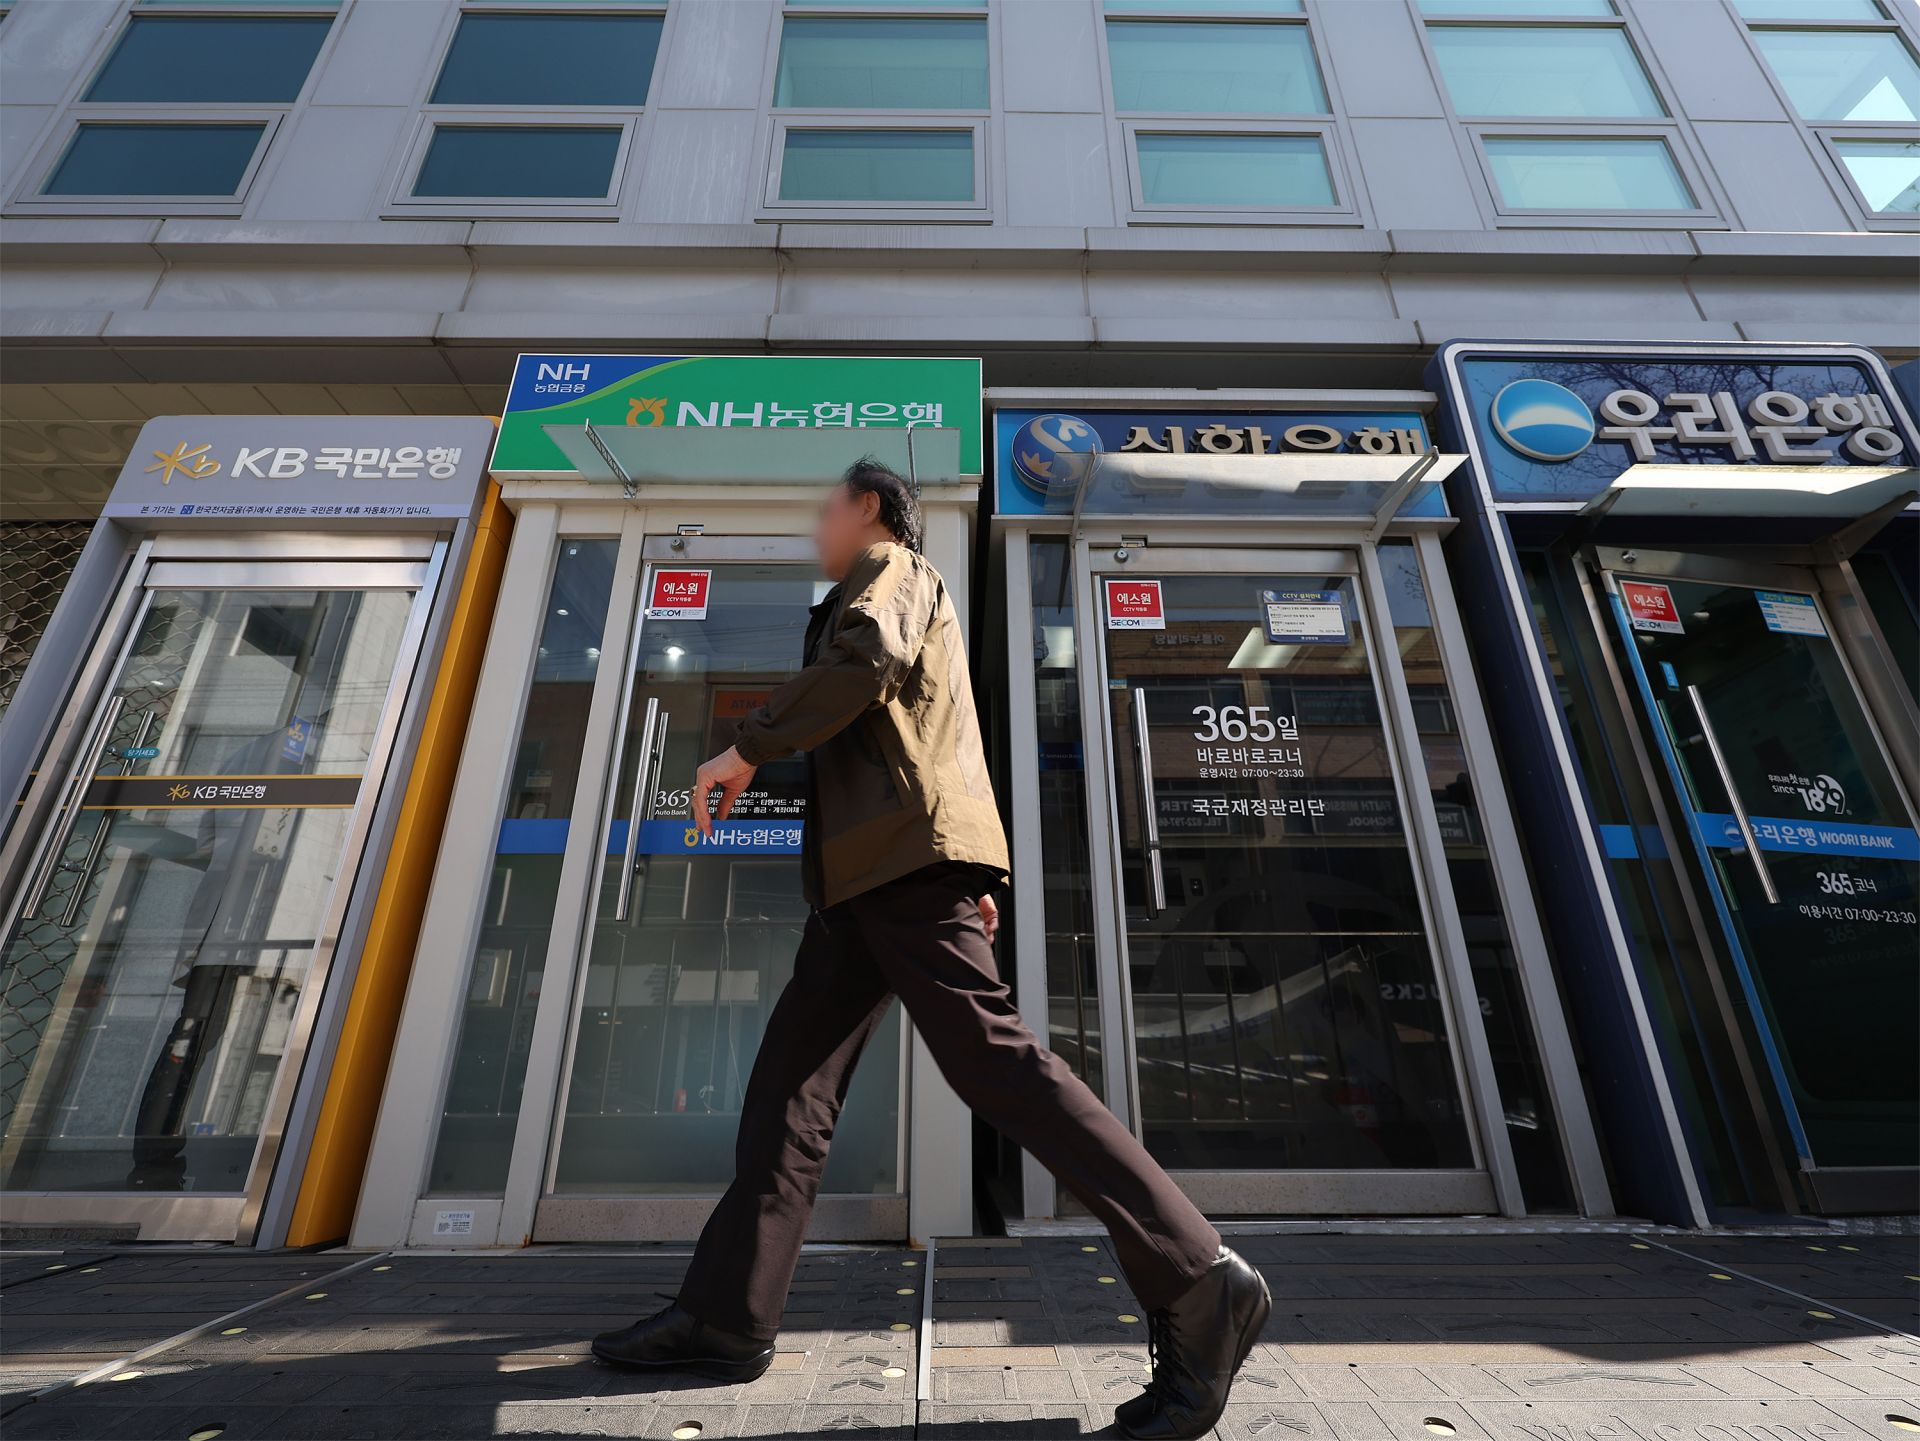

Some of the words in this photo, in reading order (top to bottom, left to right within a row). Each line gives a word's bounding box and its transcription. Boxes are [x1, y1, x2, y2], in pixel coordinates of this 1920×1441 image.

[537, 363, 590, 381] NH
[534, 383, 586, 393] 농협금융
[1599, 389, 1904, 463] 우리은행
[230, 446, 463, 479] KB국민은행
[140, 506, 149, 514] 본
[152, 506, 176, 514] 기기는
[196, 506, 272, 515] 한국전자금융(주)에서
[275, 506, 307, 515] 운영하는
[310, 506, 342, 515] 국민은행
[344, 506, 360, 515] 제휴
[363, 506, 403, 515] 자동화기기
[406, 506, 431, 515] 입니다.
[663, 582, 698, 595] 에스원
[1116, 592, 1152, 605] 에스원
[1633, 593, 1667, 609] 에스원
[651, 609, 681, 617] SECOM
[1192, 705, 1300, 742] 365일
[127, 749, 155, 757] 당기세요
[1196, 747, 1303, 765] 바로바로코너
[1199, 767, 1237, 778] 운영시간
[1242, 768, 1304, 778] 07:00~23:30
[193, 785, 266, 799] KB국민은행
[1772, 785, 1796, 794] since
[655, 789, 690, 808] 365
[1192, 799, 1325, 817] 국군재정관리단
[703, 829, 802, 847] NH농협은행
[1819, 831, 1859, 846] WOORI
[1860, 834, 1894, 849] BANK
[1799, 904, 1844, 920] 이용시간
[1845, 907, 1916, 923] 07:00~23:30
